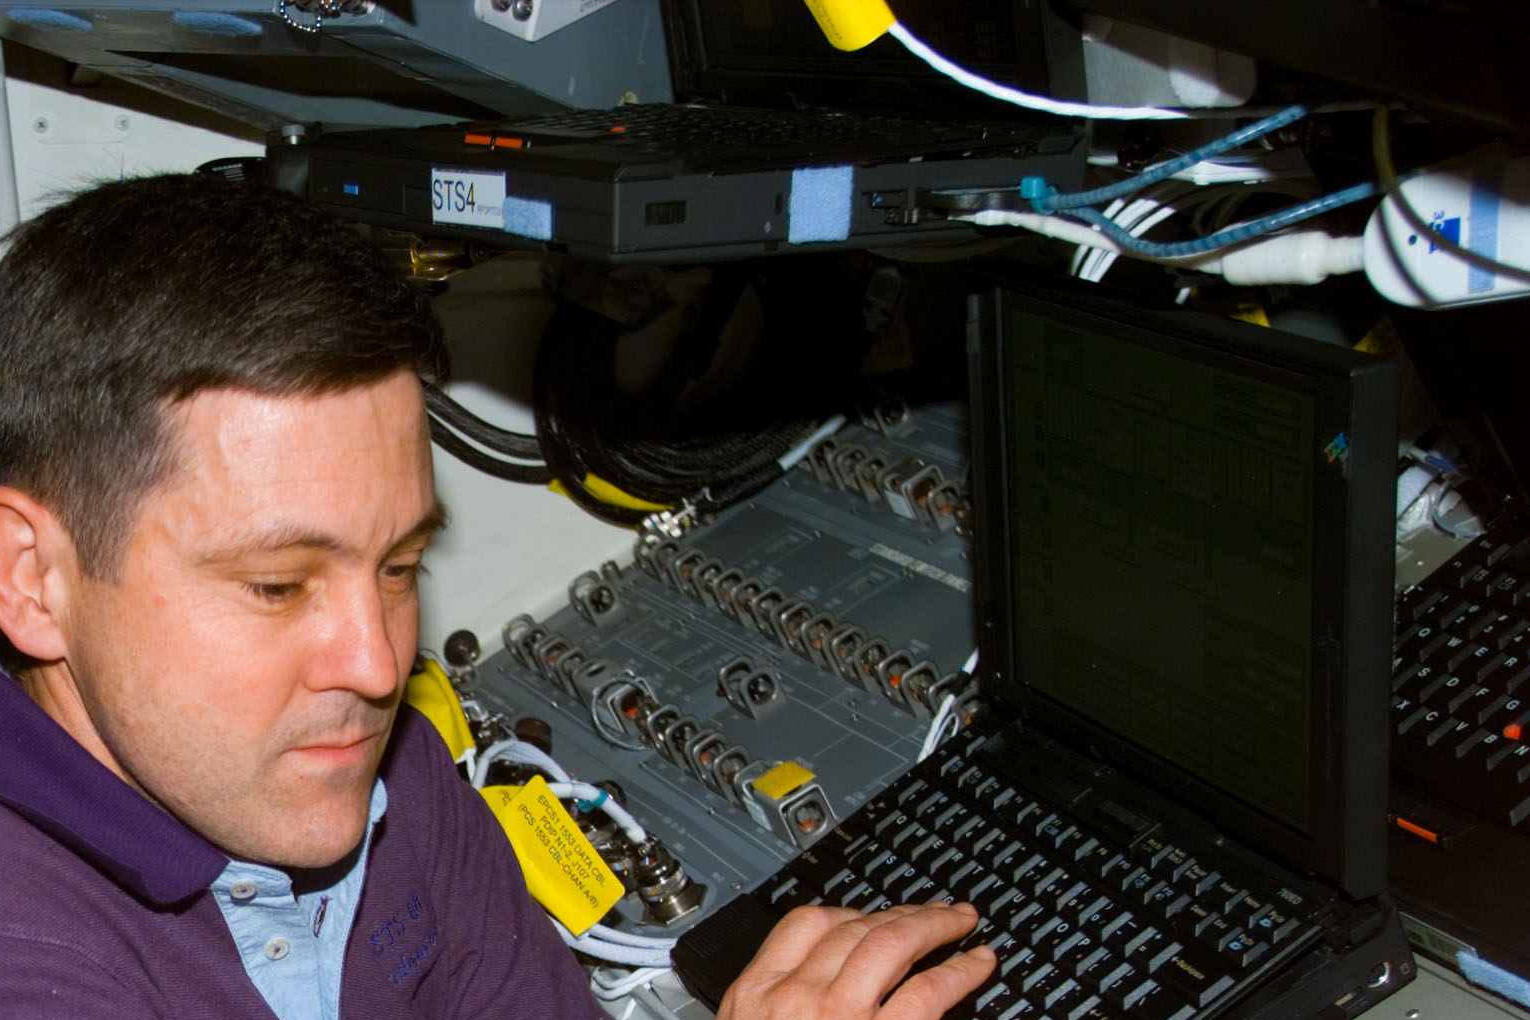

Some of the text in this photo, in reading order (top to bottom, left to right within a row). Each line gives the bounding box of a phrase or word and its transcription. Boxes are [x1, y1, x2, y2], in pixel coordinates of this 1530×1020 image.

[433, 179, 476, 213] STS4
[538, 795, 559, 824] EPCS1
[574, 846, 593, 869] DATA
[540, 816, 558, 837] PDIP
